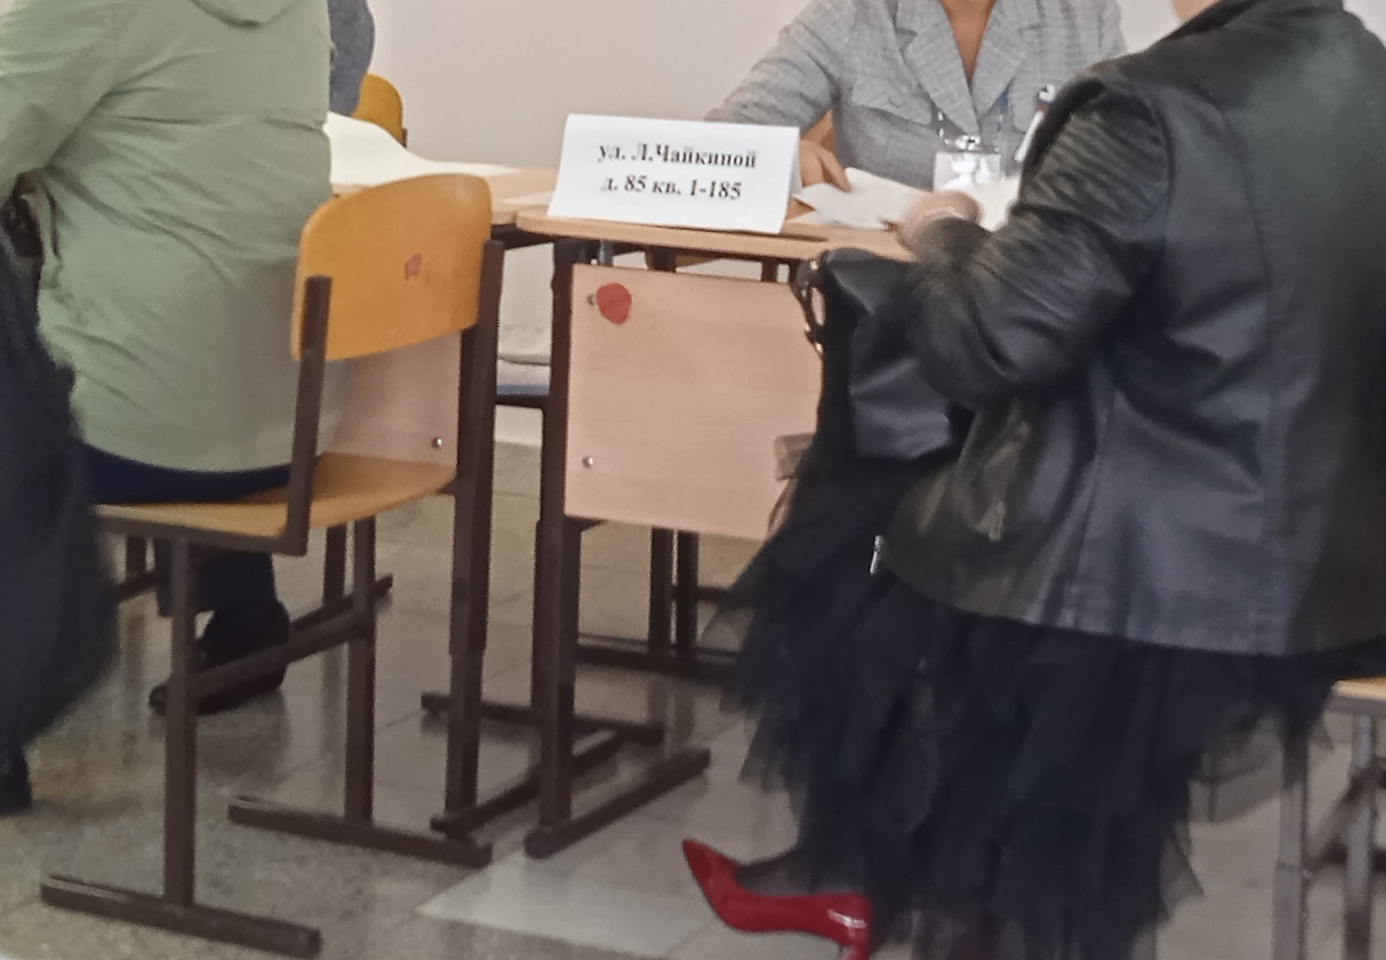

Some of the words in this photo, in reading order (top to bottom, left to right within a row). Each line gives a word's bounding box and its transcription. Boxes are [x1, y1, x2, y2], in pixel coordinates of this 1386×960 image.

[597, 143, 626, 162] ул.
[601, 177, 618, 192] д.
[624, 174, 647, 192] 85
[652, 180, 682, 195] кв.
[690, 178, 742, 200] 1-185
